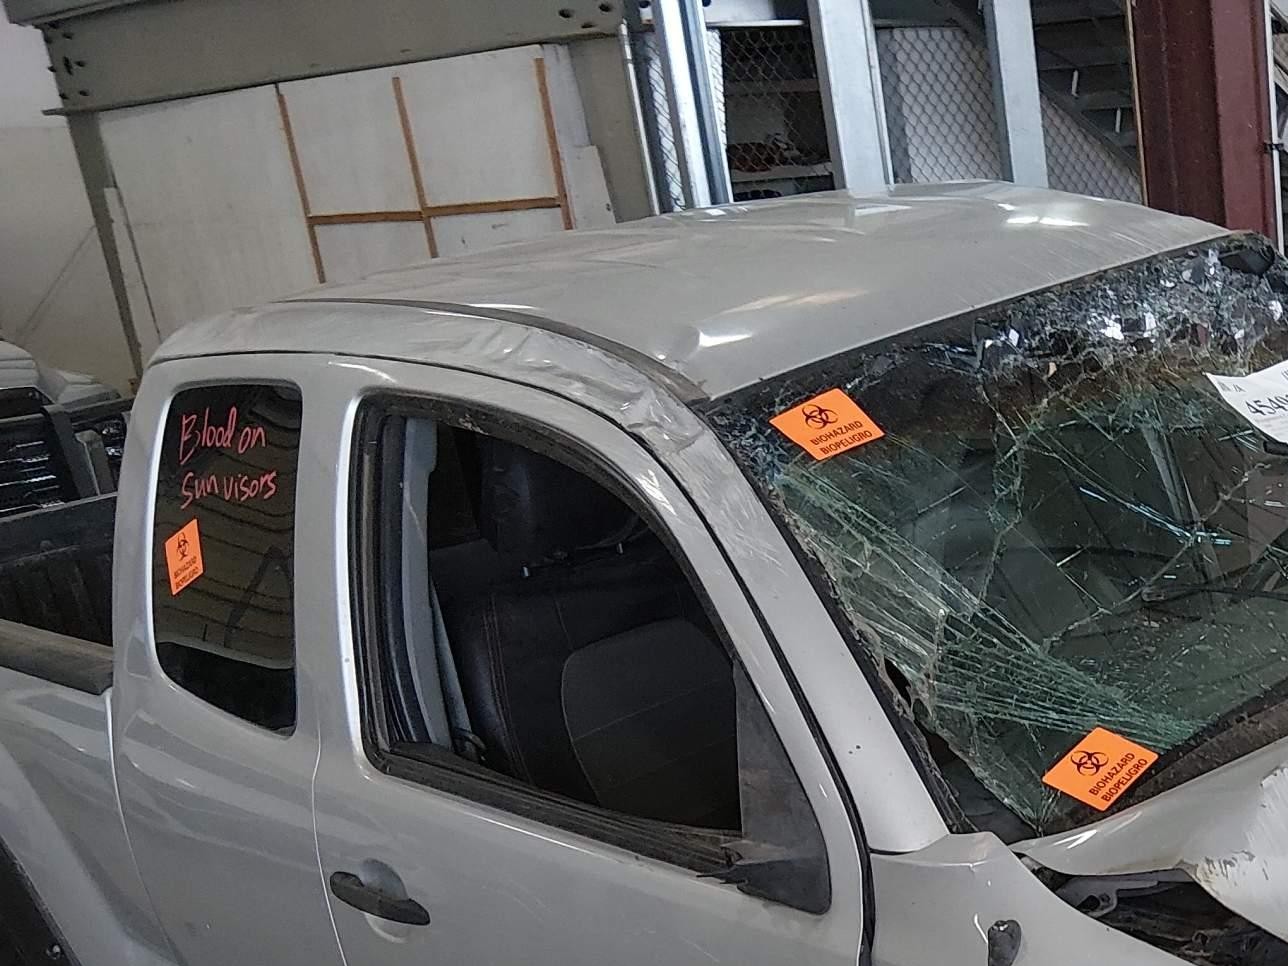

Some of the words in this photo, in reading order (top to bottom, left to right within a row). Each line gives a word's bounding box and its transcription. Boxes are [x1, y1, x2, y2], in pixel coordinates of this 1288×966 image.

[179, 406, 238, 465] Blood
[238, 425, 267, 454] on
[809, 420, 864, 446] BIOHAZARD
[819, 430, 873, 455] BIOPELIGRO
[223, 470, 278, 502] visors
[1088, 752, 1136, 796] BIOHAZARD
[1100, 757, 1148, 803] BIOPELIGRO
